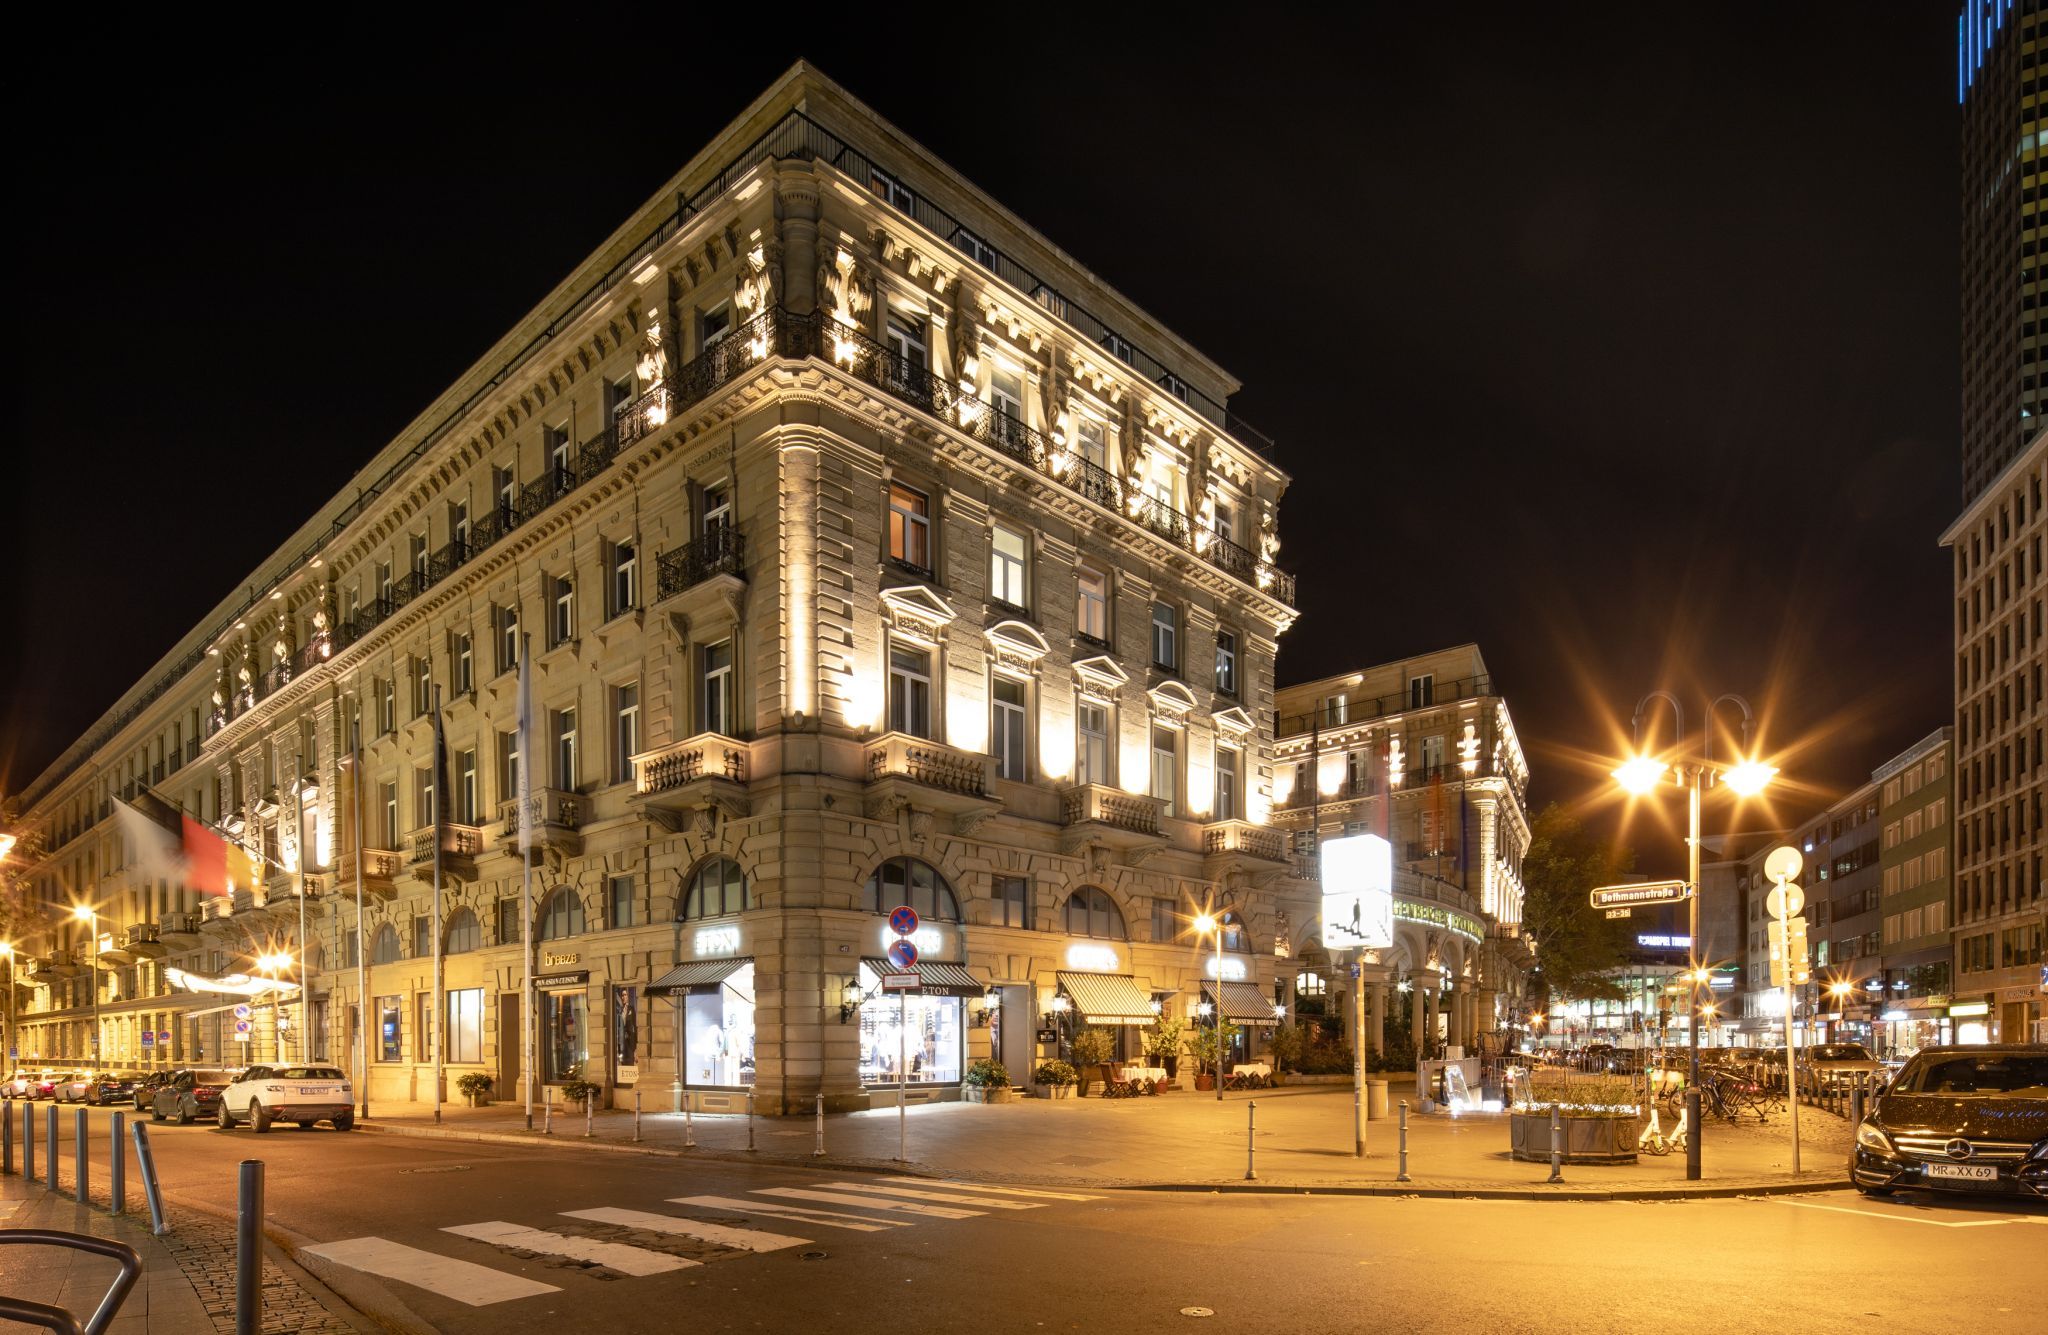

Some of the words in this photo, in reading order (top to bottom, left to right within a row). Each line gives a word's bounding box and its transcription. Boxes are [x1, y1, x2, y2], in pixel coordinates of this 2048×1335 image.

[1601, 887, 1674, 902] Bethmannstraße
[695, 932, 737, 951] ETON
[545, 952, 577, 966] breeze
[559, 976, 579, 984] CUISINE
[670, 986, 692, 996] ETON
[921, 987, 949, 995] ETON
[1087, 1016, 1123, 1024] BRASSERIE
[1123, 1017, 1155, 1025] MODERNE
[621, 1070, 638, 1078] ETON
[1932, 1165, 1948, 1175] MR
[1956, 1166, 1972, 1177] XX
[1975, 1167, 1991, 1178] 69
